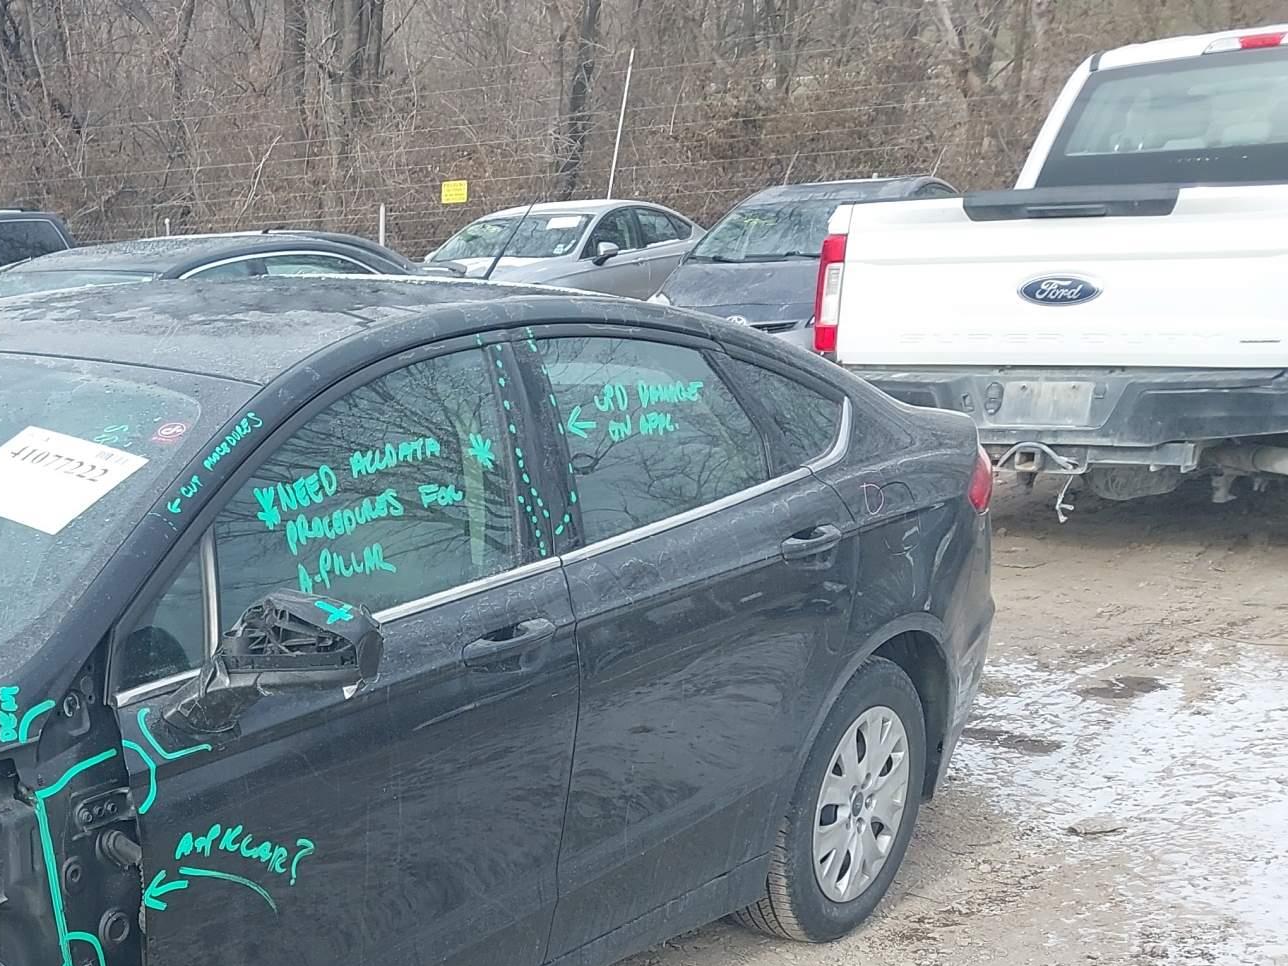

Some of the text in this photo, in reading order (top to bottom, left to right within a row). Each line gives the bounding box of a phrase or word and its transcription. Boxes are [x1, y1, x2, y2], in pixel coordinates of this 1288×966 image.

[1034, 279, 1083, 300] Ford
[10, 445, 109, 482] 41077222
[276, 464, 337, 513] NEED
[417, 482, 465, 508] FOR
